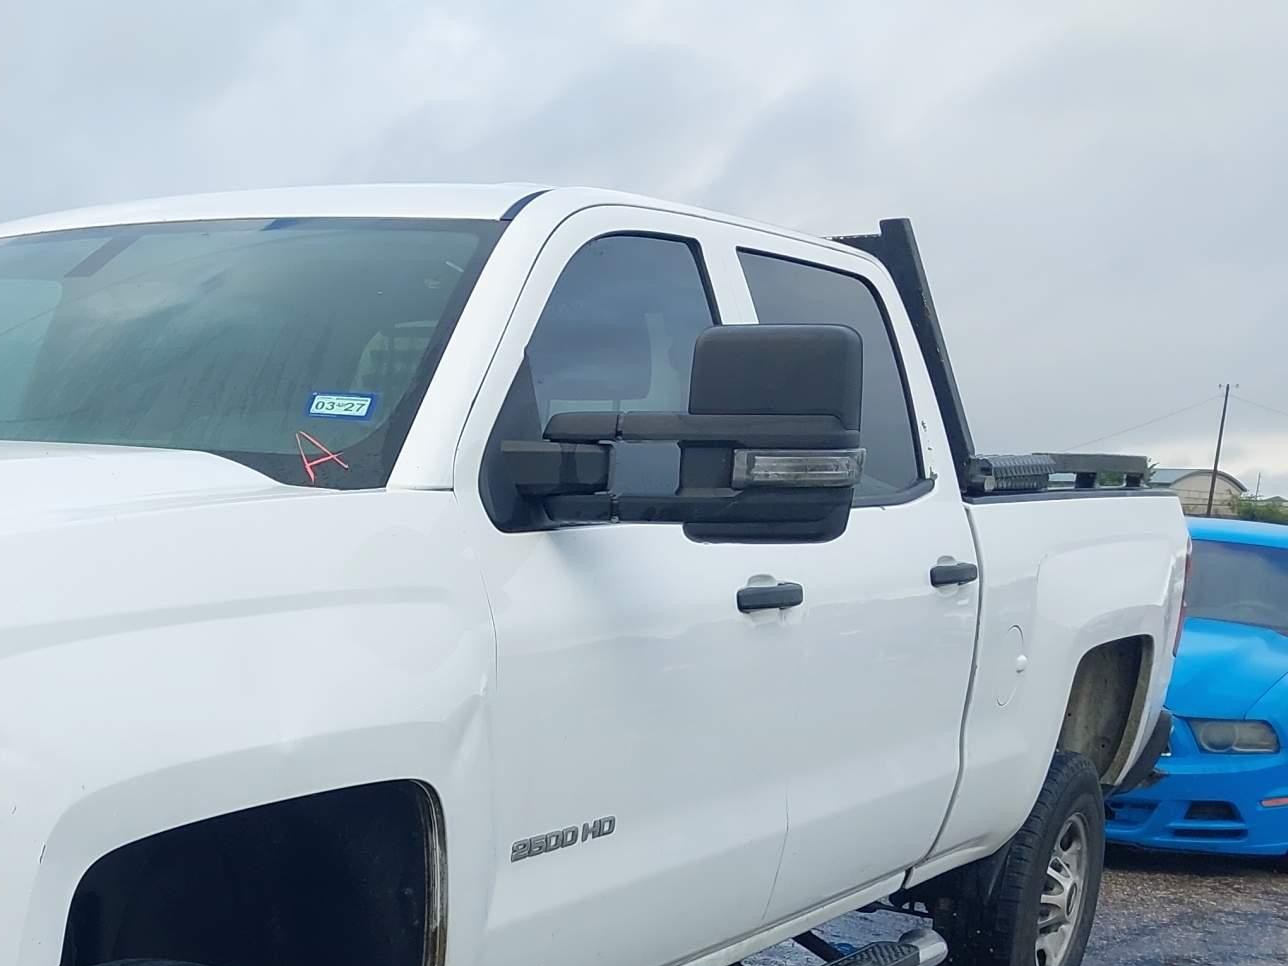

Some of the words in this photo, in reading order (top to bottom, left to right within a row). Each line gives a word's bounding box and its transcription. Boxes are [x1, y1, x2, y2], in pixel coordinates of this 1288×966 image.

[315, 401, 335, 411] 03
[344, 402, 366, 412] 27
[510, 825, 579, 863] 2500
[581, 815, 616, 843] HD
